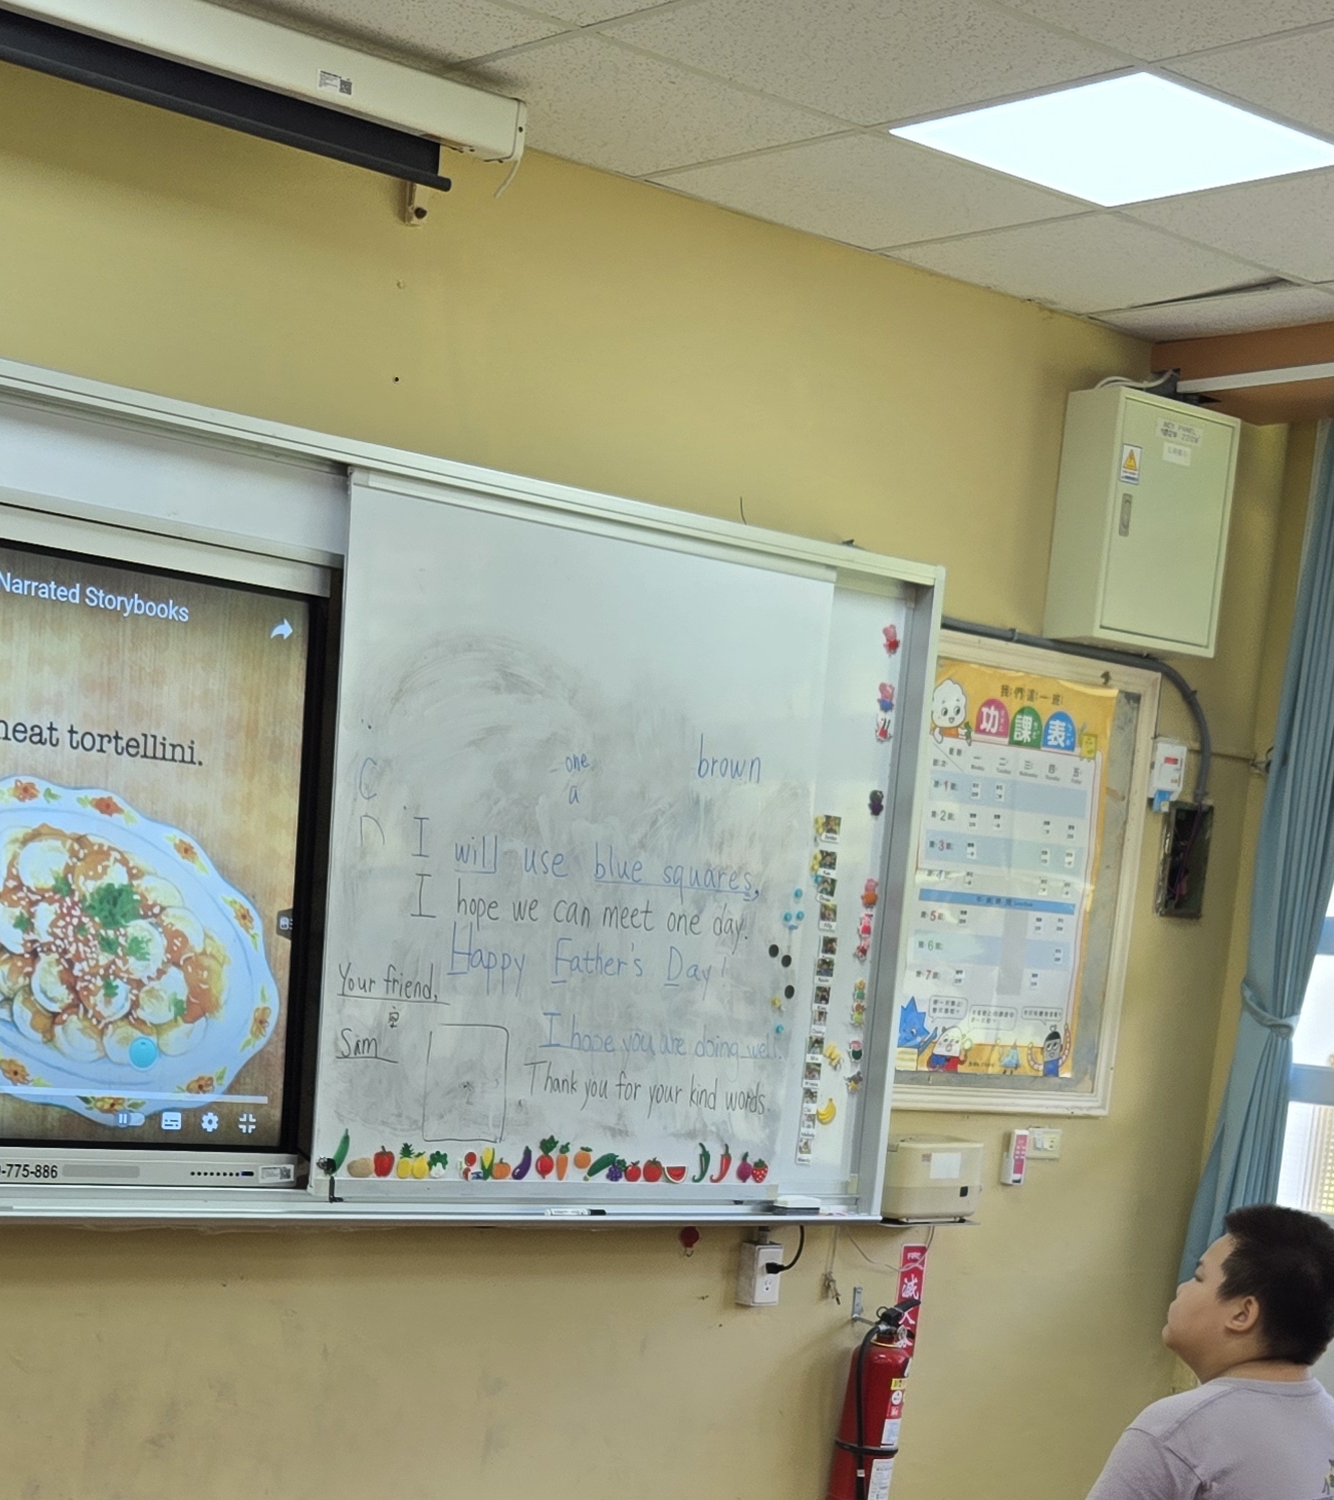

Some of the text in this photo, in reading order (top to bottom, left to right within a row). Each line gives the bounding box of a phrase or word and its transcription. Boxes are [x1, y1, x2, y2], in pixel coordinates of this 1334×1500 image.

[85, 586, 189, 622] Storybooks
[67, 724, 204, 766] tortellini.
[980, 705, 1067, 748] 功課表
[698, 733, 761, 784] brown
[453, 834, 497, 873] will
[523, 847, 569, 877] use
[594, 841, 643, 883] blue
[411, 873, 436, 918] I
[457, 878, 499, 931] hope
[512, 899, 539, 922] we
[553, 900, 591, 928] can
[602, 900, 655, 932] meet
[667, 910, 701, 936] one
[339, 962, 375, 996] Your
[450, 921, 525, 998] Happy
[555, 936, 643, 977] Father's
[340, 1028, 378, 1058] Sam
[524, 1060, 577, 1096] Thank
[579, 1078, 608, 1111] you
[616, 1070, 642, 1101] for
[648, 1079, 683, 1119] your
[689, 1073, 718, 1111] kind
